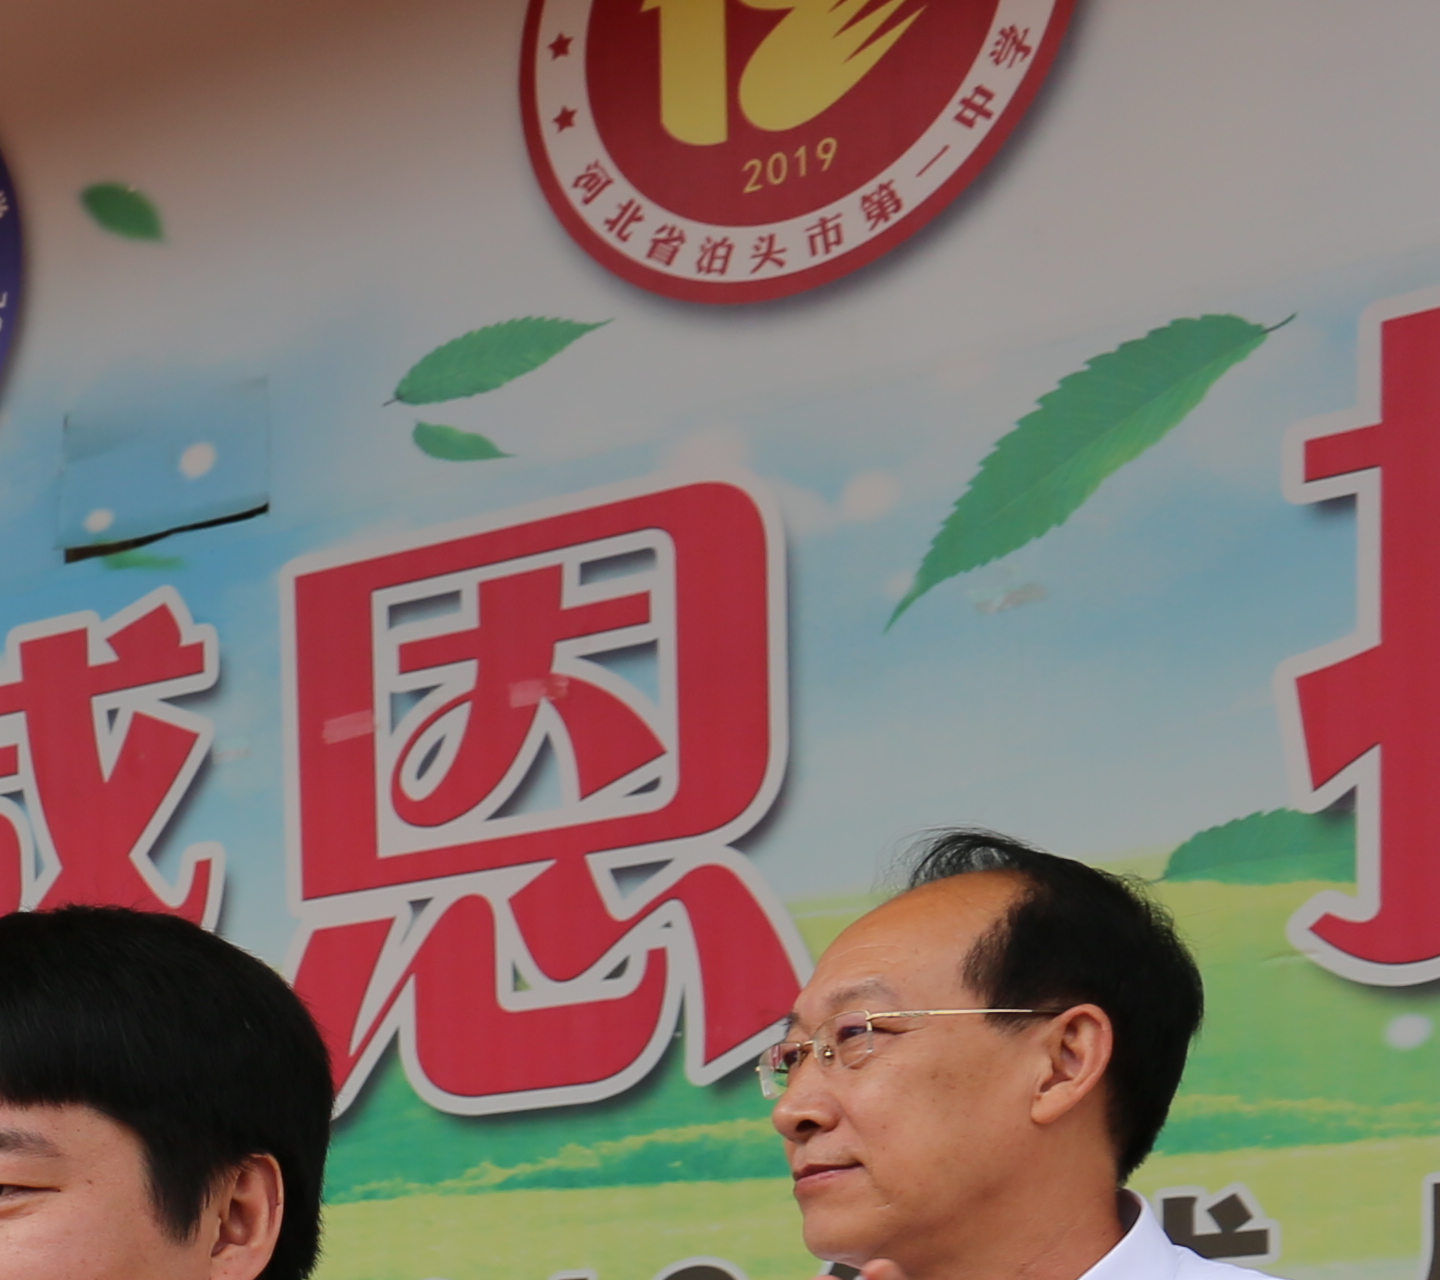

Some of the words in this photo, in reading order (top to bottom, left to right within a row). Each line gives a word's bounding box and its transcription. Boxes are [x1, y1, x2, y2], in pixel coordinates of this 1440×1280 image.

[570, 22, 1035, 277] 河北省泊头市第一中学
[740, 136, 839, 194] 2019
